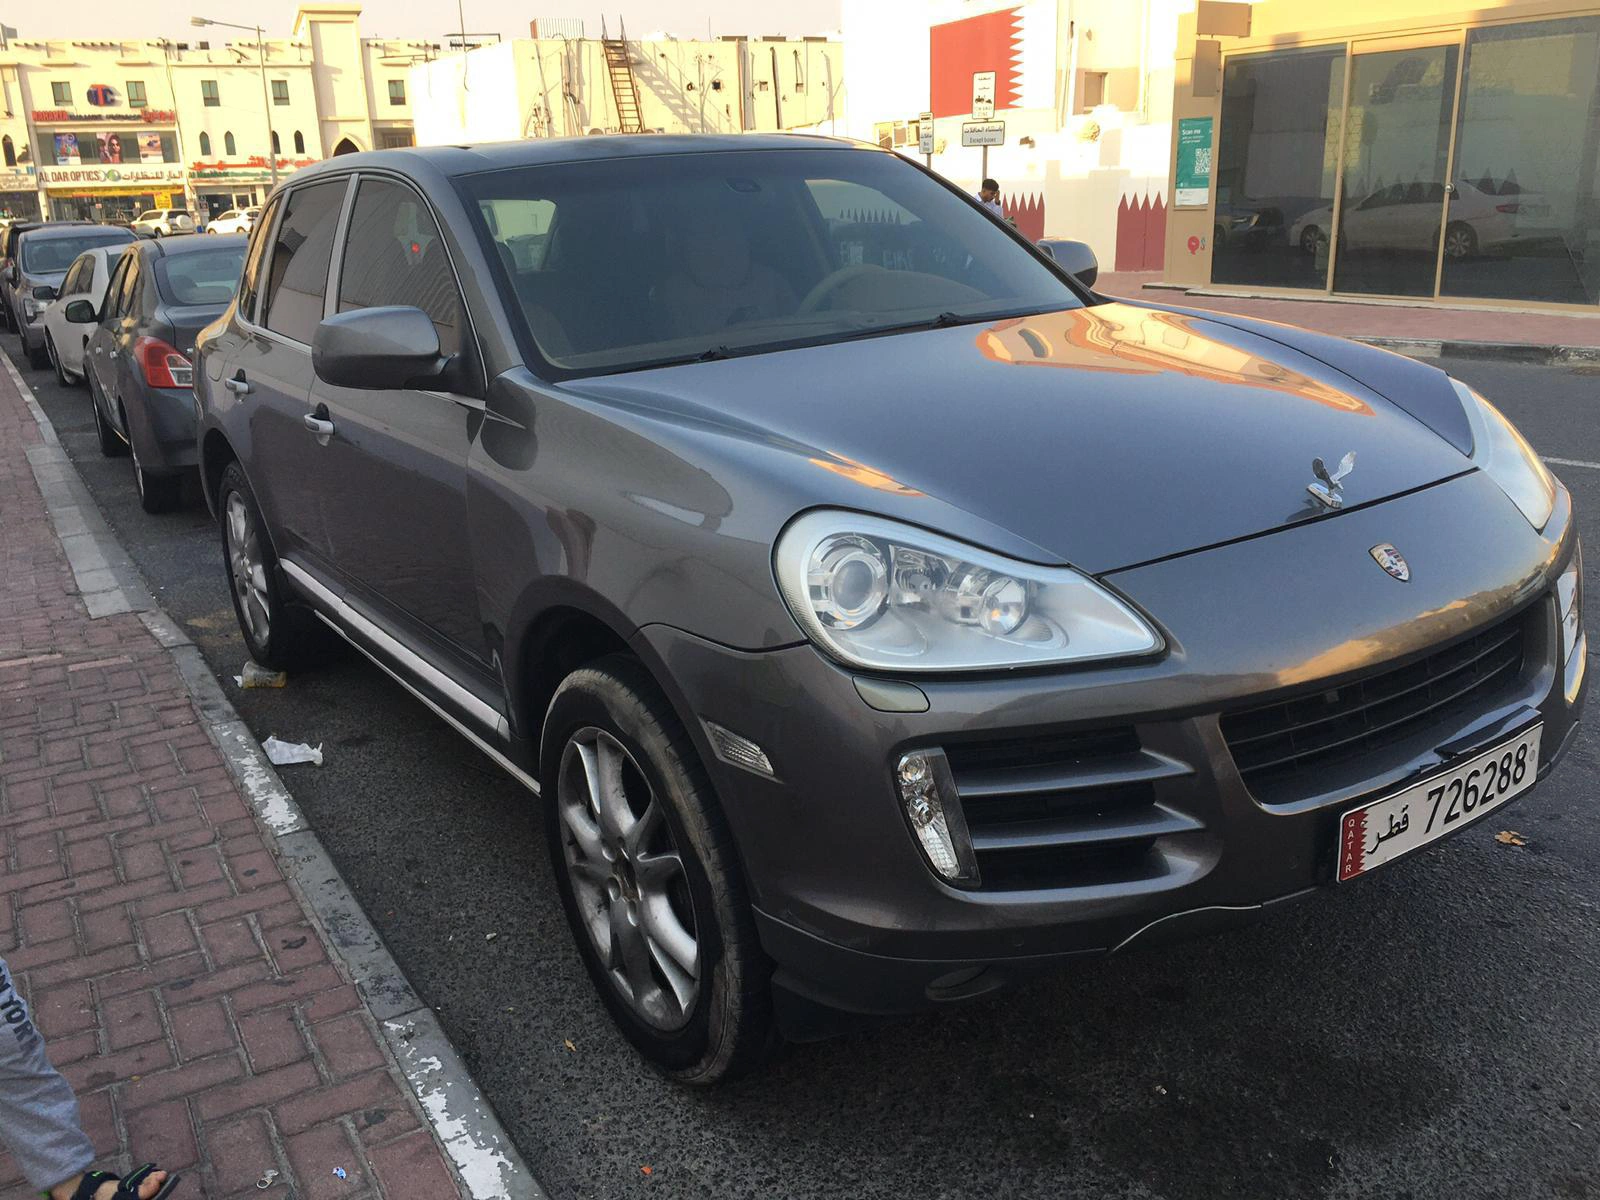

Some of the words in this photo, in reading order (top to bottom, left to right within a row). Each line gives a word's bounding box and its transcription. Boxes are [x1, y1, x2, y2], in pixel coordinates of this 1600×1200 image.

[39, 170, 50, 183] AL
[51, 171, 71, 182] DAR
[71, 170, 100, 181] OPTICS
[166, 170, 184, 181] الدار
[1424, 742, 1528, 834] 726288
[1345, 818, 1356, 874] QATAR
[1366, 804, 1410, 855] قطر
